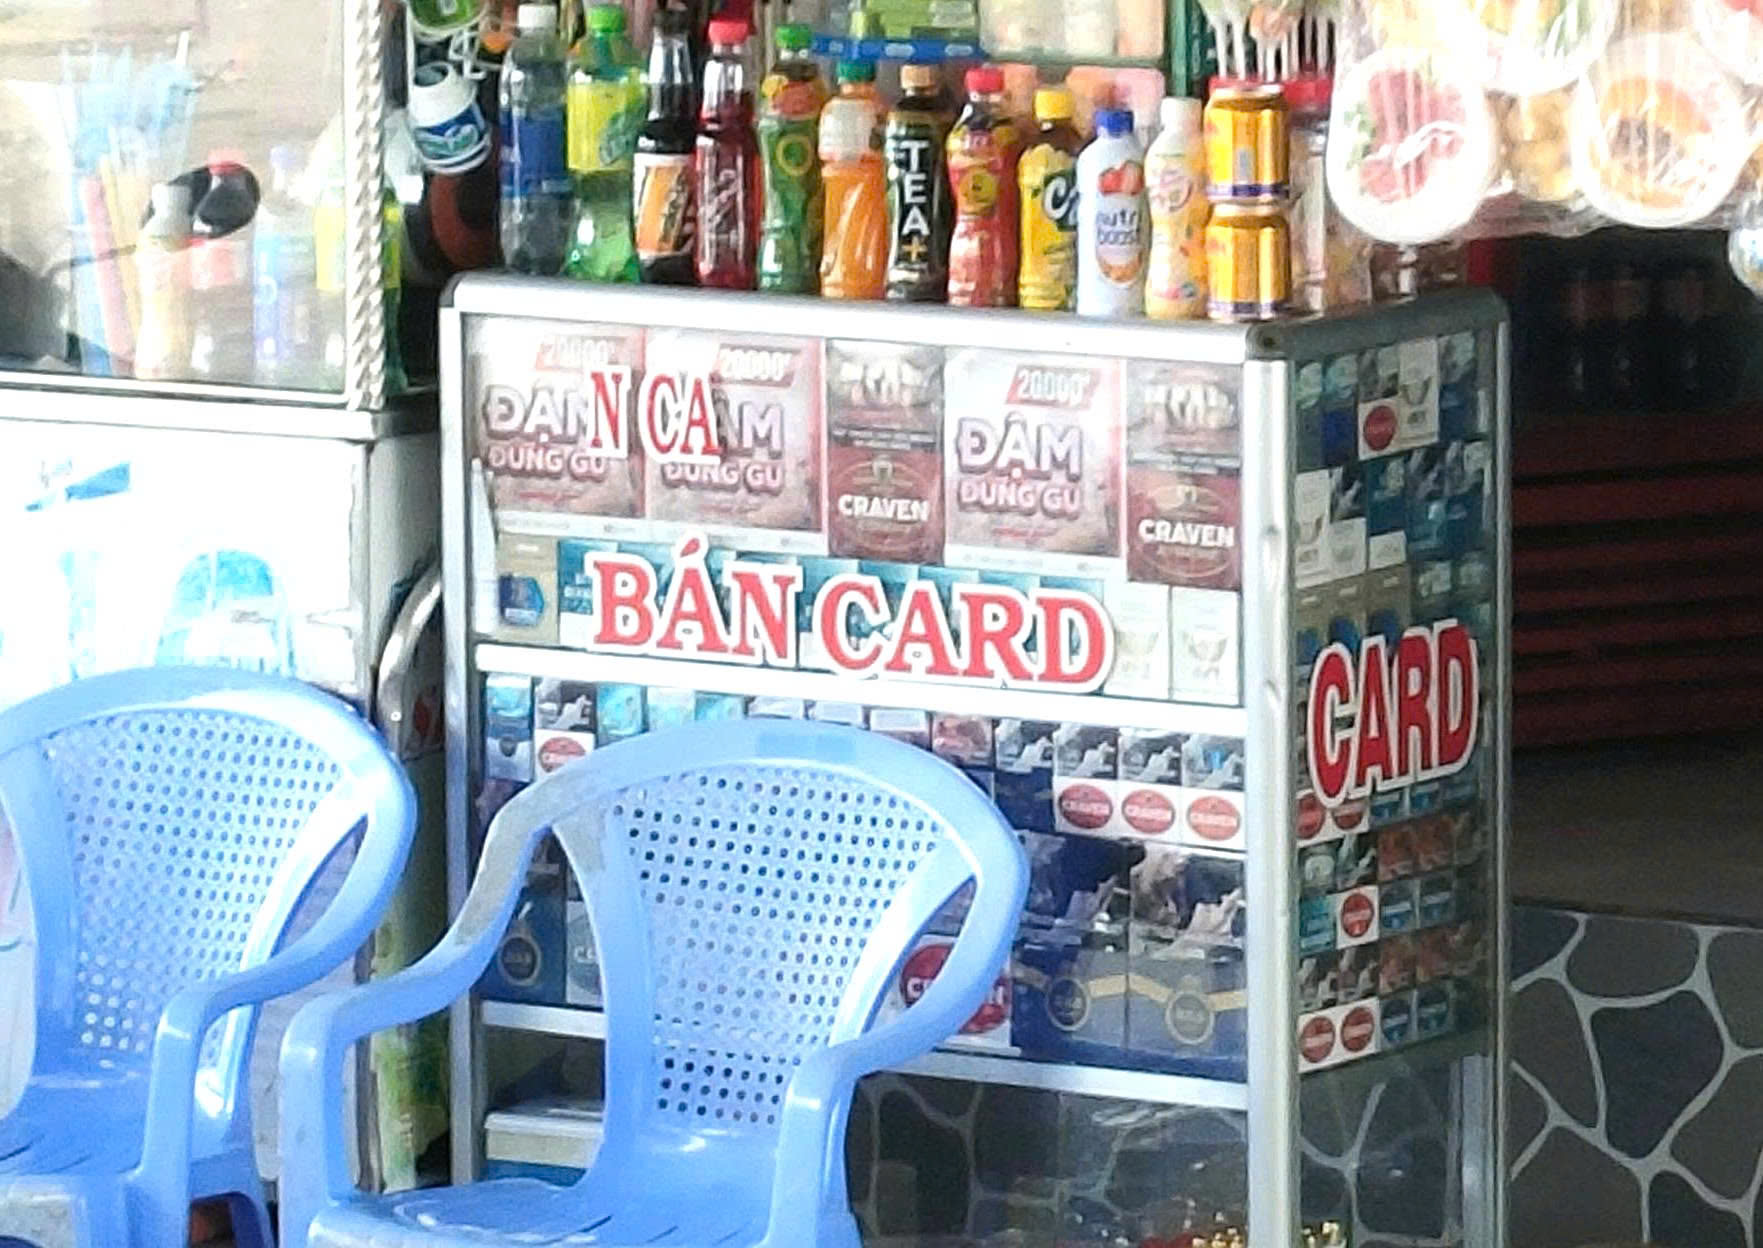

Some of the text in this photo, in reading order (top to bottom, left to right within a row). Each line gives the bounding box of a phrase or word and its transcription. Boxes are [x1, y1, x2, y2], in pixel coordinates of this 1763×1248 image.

[956, 412, 1083, 480] ĐẬM
[745, 462, 783, 491] GU
[838, 493, 929, 521] CRAVEN
[1042, 483, 1081, 514] GU
[1138, 518, 1235, 547] CRAVEN
[591, 536, 1108, 686] BÁN CARD
[1311, 624, 1475, 800] CARD
